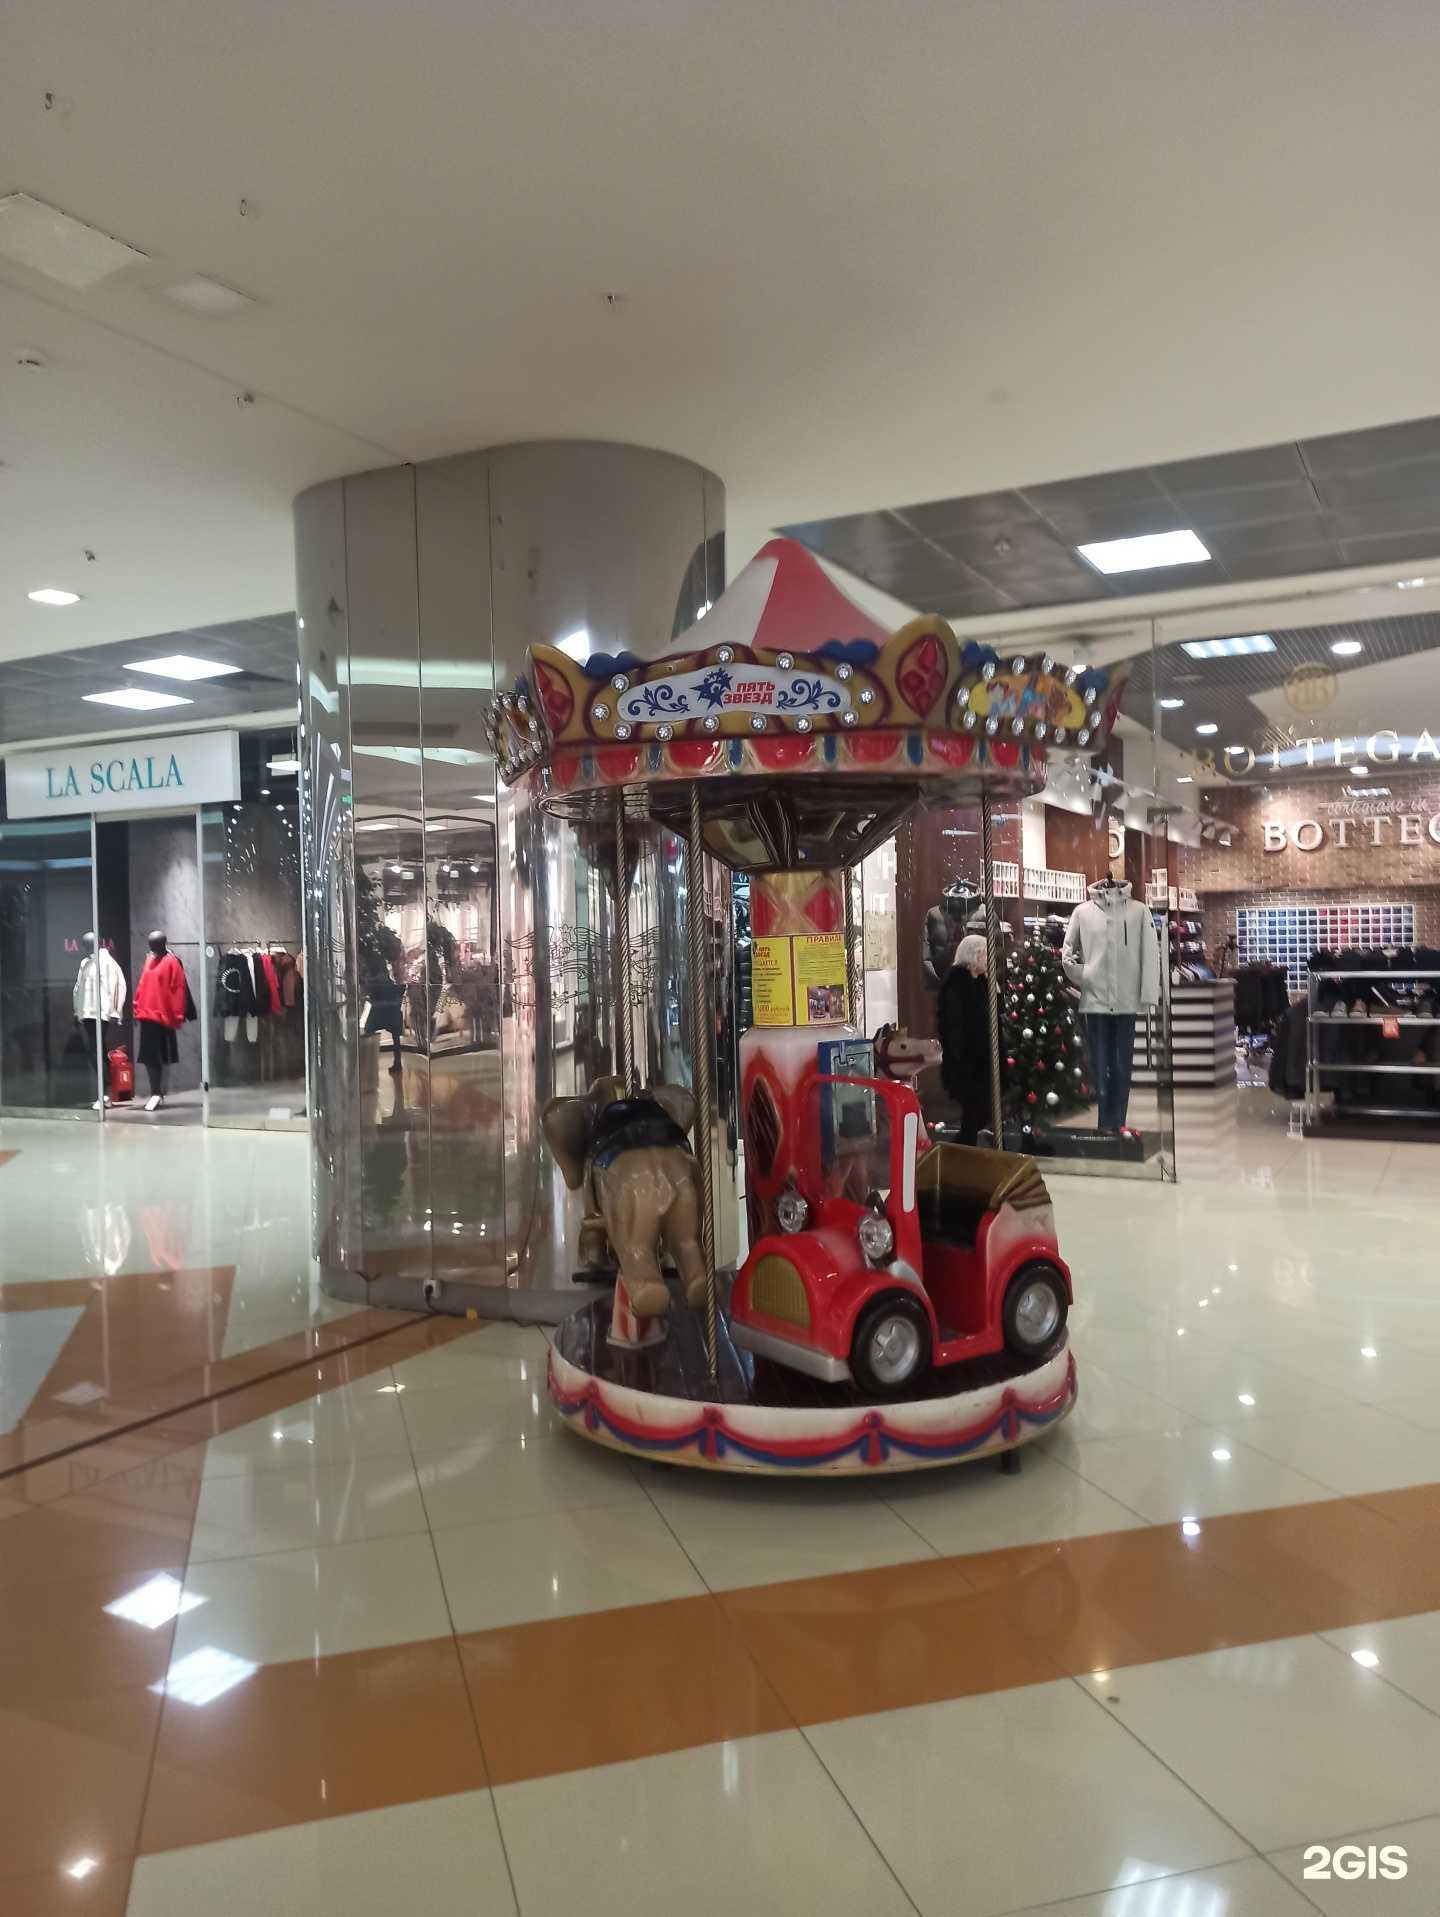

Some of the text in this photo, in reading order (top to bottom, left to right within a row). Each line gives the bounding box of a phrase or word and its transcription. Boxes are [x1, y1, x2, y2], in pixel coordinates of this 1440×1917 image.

[736, 681, 775, 692] ПЯТЬ
[723, 693, 773, 704] ЗВЕЗД
[46, 753, 184, 799] LA SCALA
